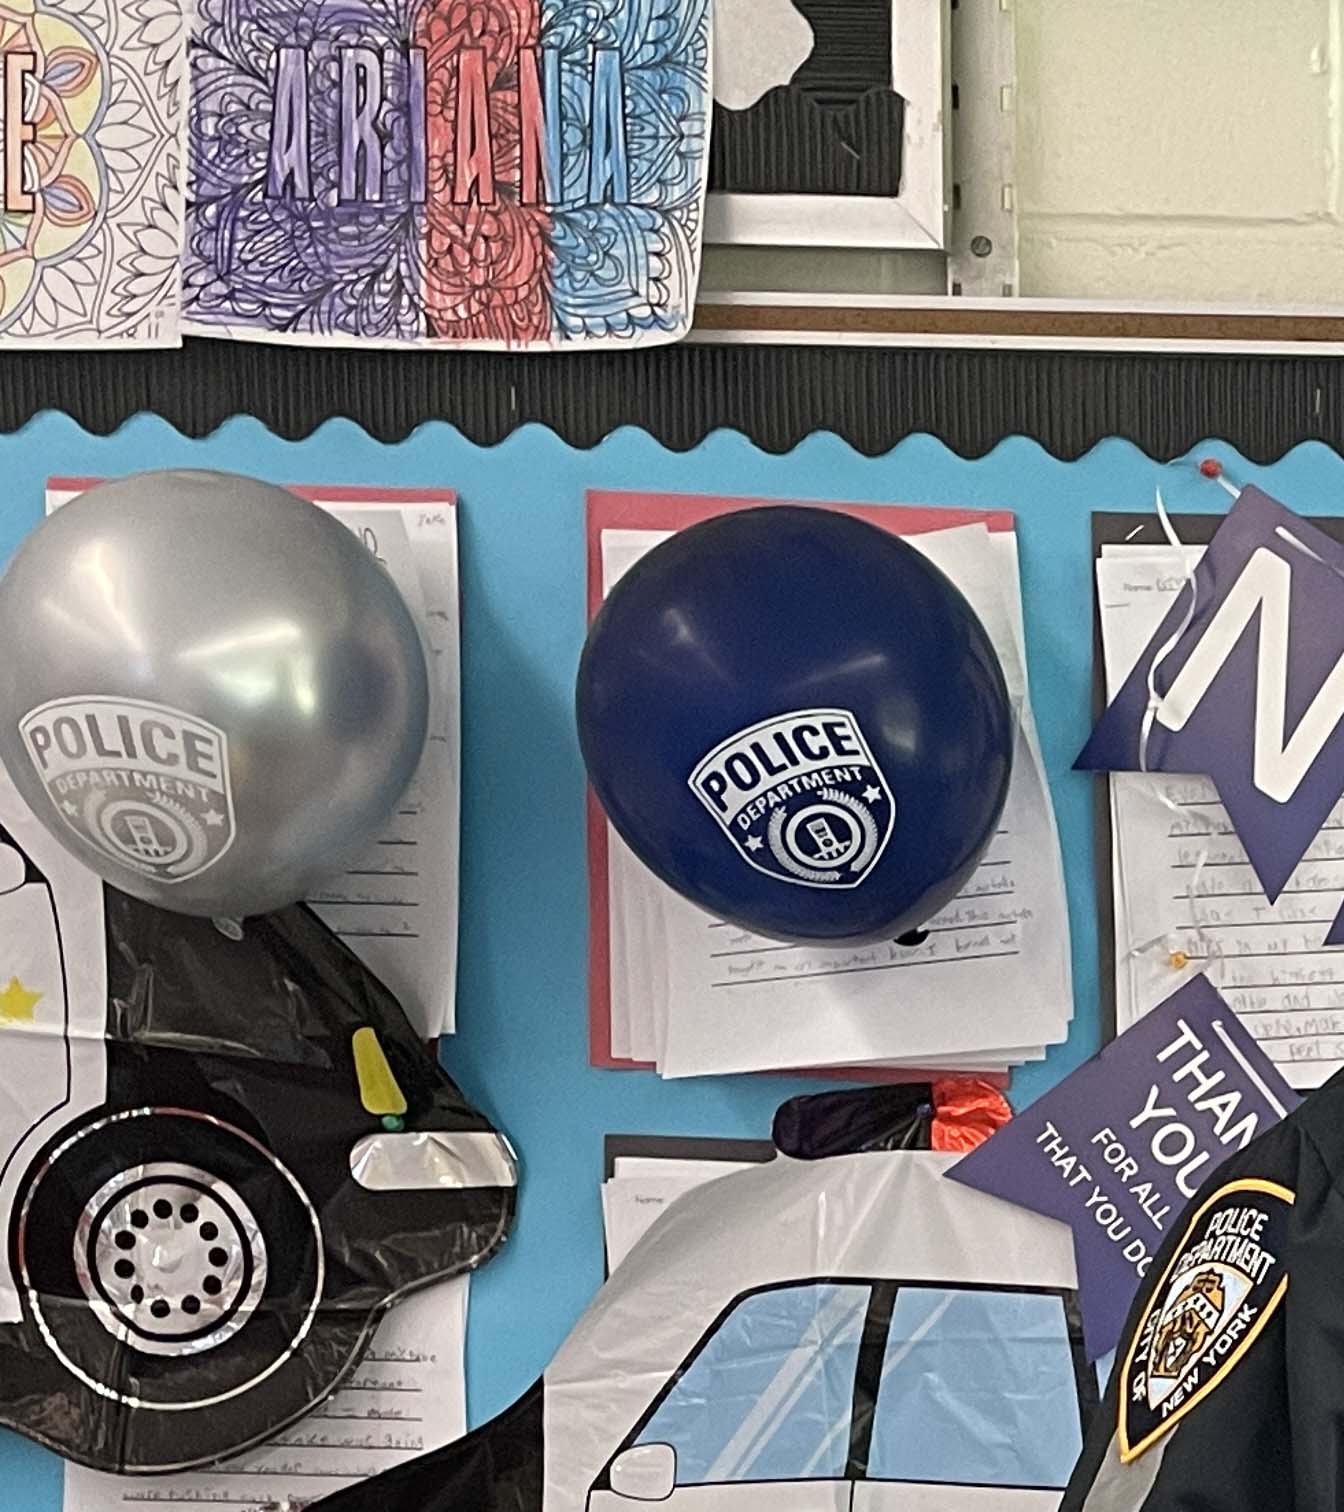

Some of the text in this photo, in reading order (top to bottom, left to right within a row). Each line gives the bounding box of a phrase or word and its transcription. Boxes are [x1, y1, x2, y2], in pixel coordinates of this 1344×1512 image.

[31, 713, 218, 781] POLICE
[57, 766, 212, 803] DEPARTMENT
[701, 720, 863, 812] POLICE
[737, 764, 864, 831] DEPARTMENT
[1156, 1018, 1259, 1150] THAN
[1034, 1121, 1093, 1187] THAT
[1083, 1184, 1134, 1244] YOU
[1090, 1127, 1174, 1232] FOR ALL
[1170, 1235, 1277, 1286] DEPARTMENT
[1203, 1207, 1270, 1242] POLICE
[1161, 1302, 1259, 1418] NEW YORK
